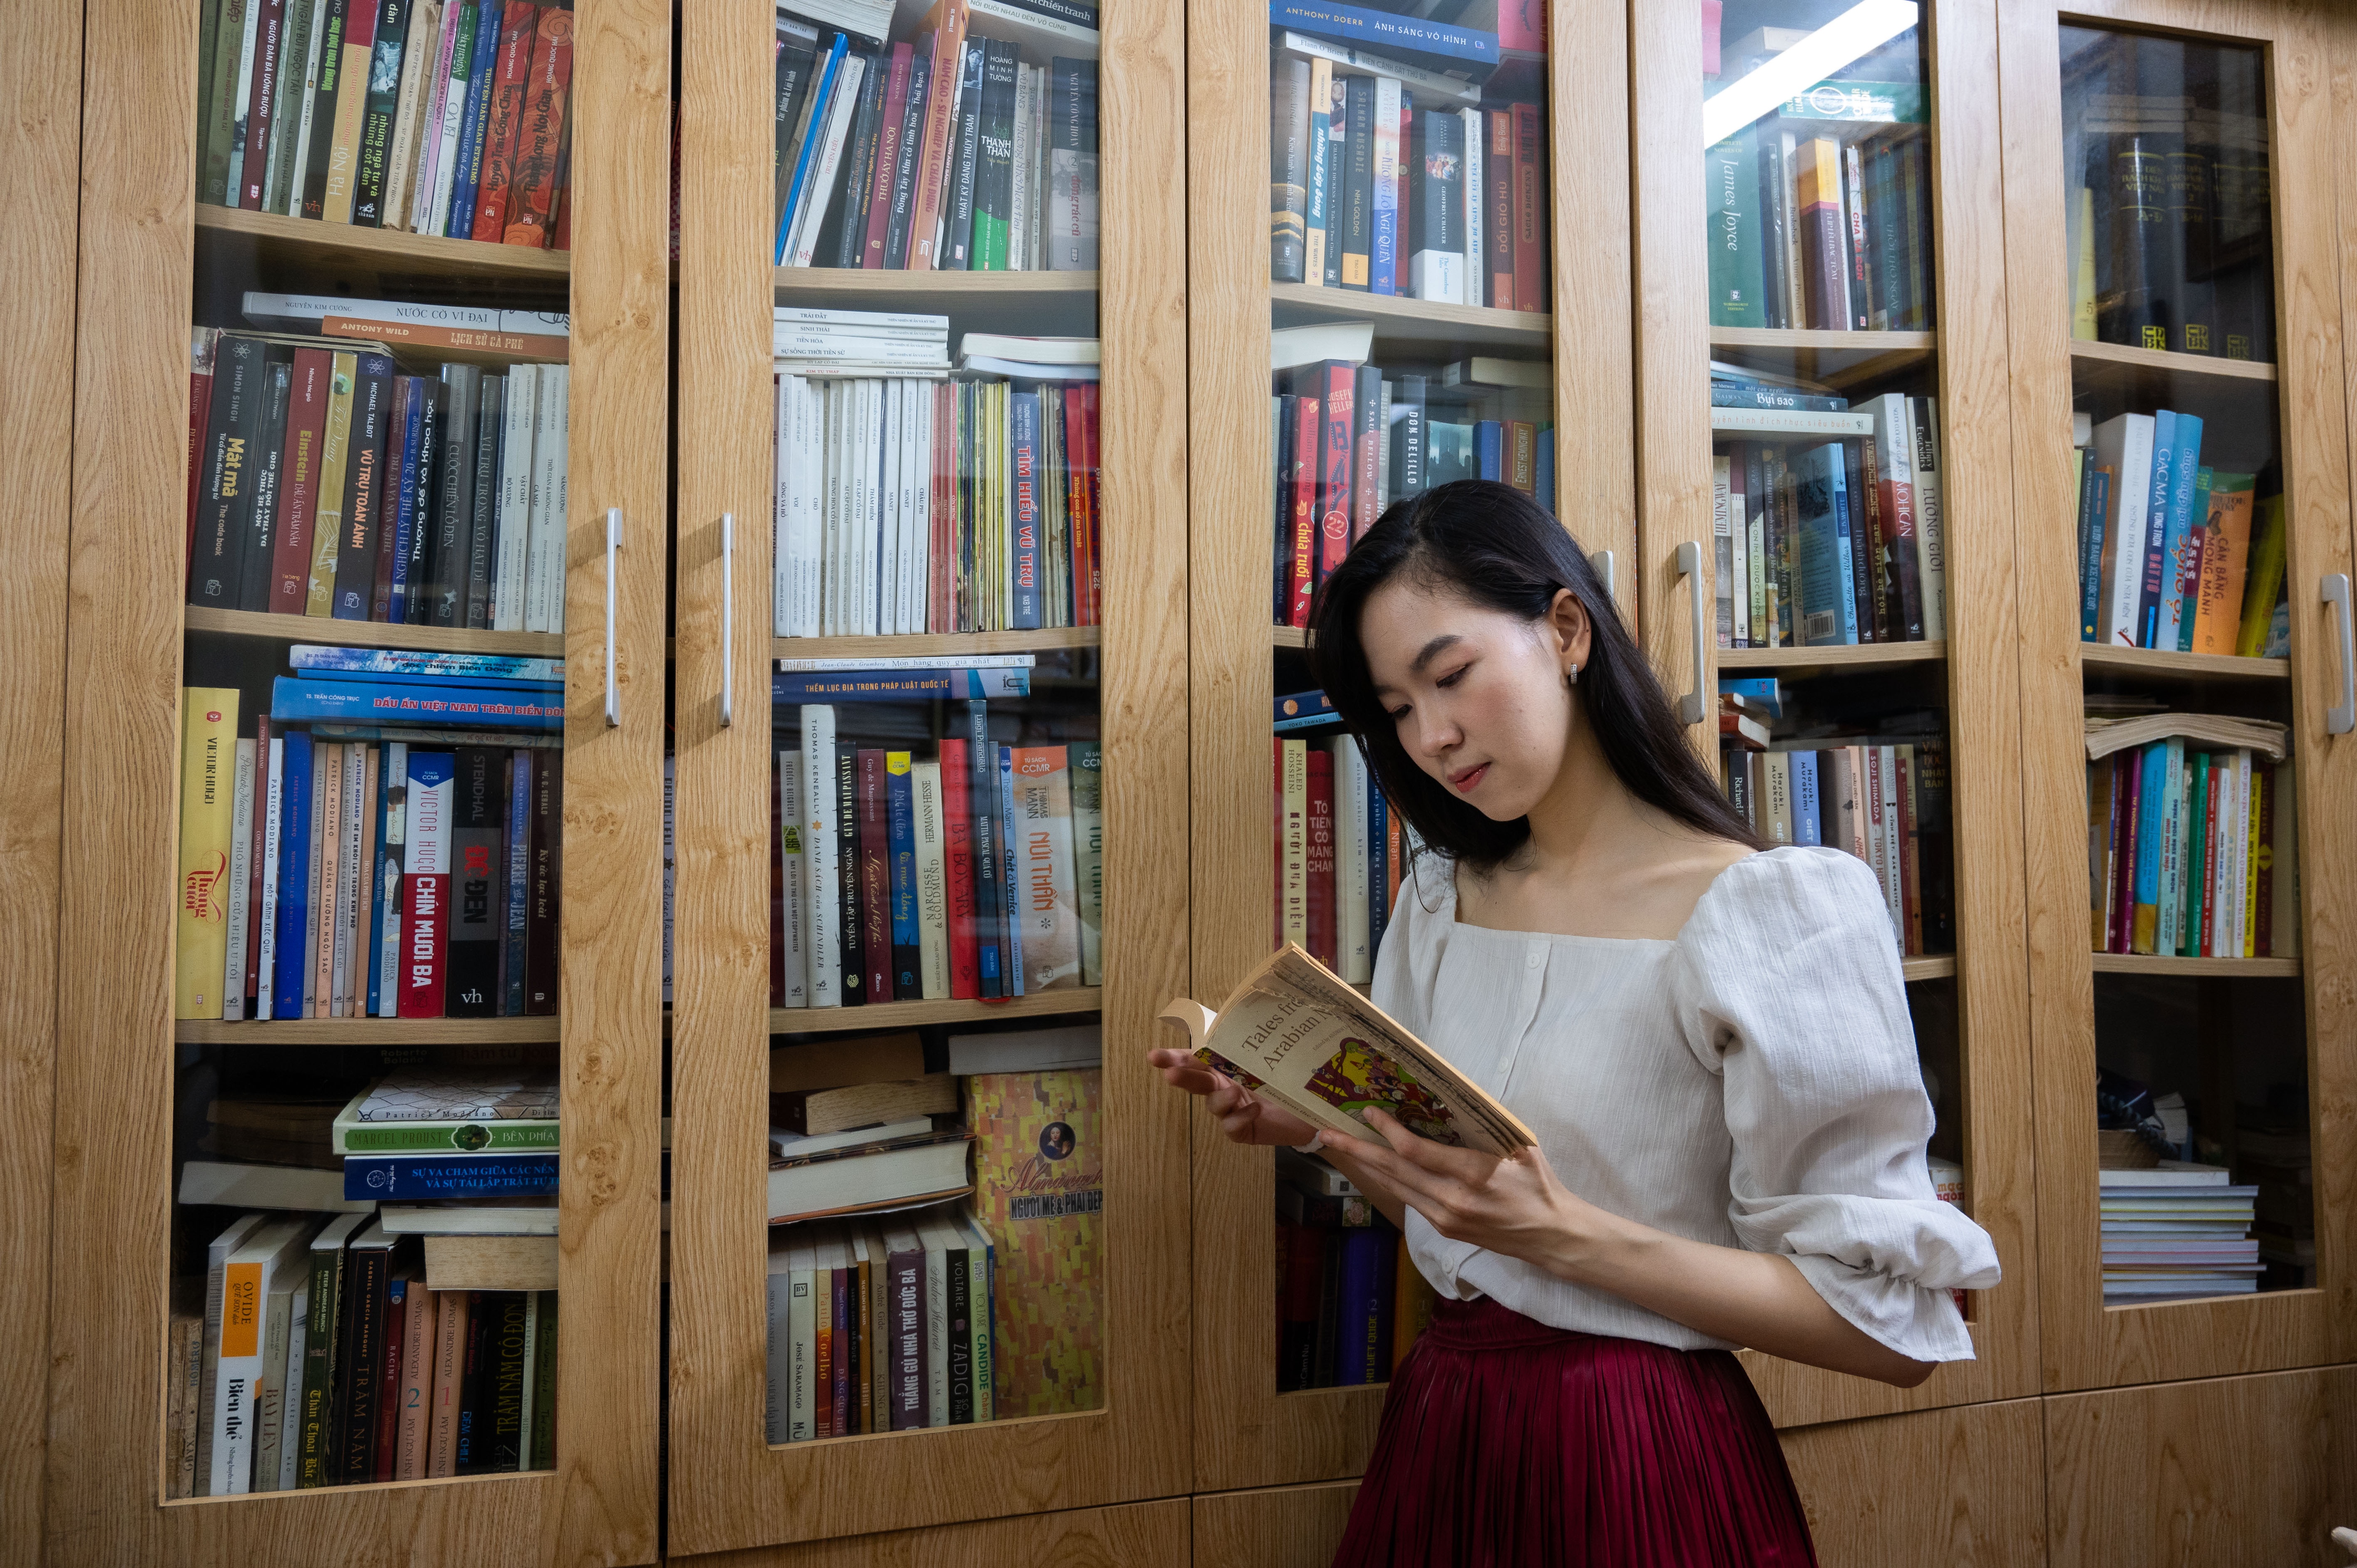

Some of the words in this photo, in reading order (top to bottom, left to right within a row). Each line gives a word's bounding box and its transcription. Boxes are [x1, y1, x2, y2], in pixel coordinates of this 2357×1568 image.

[1001, 8, 1020, 17] NHAU
[1022, 13, 1035, 22] ĐẾN
[1286, 7, 1330, 20] ANTHONY
[1334, 15, 1363, 26] DOERR
[268, 19, 277, 45] NGƯỜI
[1301, 39, 1317, 50] Flann
[1375, 21, 1394, 32] ÁNH
[1398, 25, 1424, 37] SÁNG
[1427, 31, 1439, 40] VÔ
[1443, 33, 1466, 45] HÌNH
[265, 61, 272, 72] BÀ
[990, 56, 1012, 64] HOÀNG
[263, 73, 272, 96] UỐNG
[990, 74, 1012, 82] TƯỜNG
[260, 96, 269, 117] RƯỢU
[333, 147, 350, 172] Nội
[963, 160, 972, 183] ĐẶNG
[329, 176, 345, 196] Hà
[961, 184, 969, 196] KÝ
[1719, 158, 1740, 205] James
[1722, 210, 1741, 251] Joyce
[396, 305, 428, 320] NƯỚC
[432, 307, 447, 320] CỜ
[468, 312, 488, 323] ĐẠI
[341, 323, 383, 333] ANTONY
[386, 327, 410, 336] WILD
[234, 365, 243, 393] SIMON
[231, 395, 240, 422] SINGH
[369, 382, 377, 412] MICHAEL
[1327, 389, 1353, 402] JOSEPH
[1328, 401, 1353, 414] HELLER
[1756, 393, 1775, 407] Bụi
[1777, 396, 1794, 406] sao
[366, 413, 375, 438] TALBOT
[226, 437, 246, 468] Mật
[295, 430, 312, 482] Einstein
[1518, 428, 1528, 461] HEMINGWAY
[1018, 446, 1035, 477] TÌM
[1303, 455, 1313, 493] Golding
[1515, 461, 1527, 483] ERNEST
[222, 470, 238, 497] mã
[220, 504, 228, 519] The
[1019, 482, 1038, 521] HIỂU
[1715, 481, 1730, 536] HEMINGWAY
[1895, 482, 1911, 538] MOHICAN
[217, 520, 226, 536] code
[1020, 526, 1036, 548] VŨ
[1329, 516, 1345, 533] 22
[215, 538, 224, 556] book
[1018, 553, 1033, 587] TRỤ
[2174, 535, 2188, 595] QUỐC
[805, 684, 824, 693] THỀM
[827, 684, 840, 692] LỤC
[842, 683, 855, 692] ĐỊA
[857, 682, 879, 691] TRONG
[881, 681, 899, 690] PHÁP
[901, 681, 918, 689] LUẬT
[920, 679, 938, 689] QUỐC
[940, 679, 950, 688] TẾ
[374, 697, 398, 708] DẤU
[401, 698, 418, 709] ẤN
[421, 699, 448, 711] VIỆT
[450, 703, 479, 712] NAM
[481, 703, 512, 714] TRÊN
[514, 703, 542, 716] BIỂN
[206, 737, 217, 773] VICTOR
[1022, 764, 1050, 773] CCMR
[205, 774, 215, 804] HUGO
[472, 755, 485, 821] STENDHAL
[922, 780, 931, 800] HESSE
[1871, 778, 1880, 820] SHIMADA
[419, 790, 438, 832] VICTOR
[923, 802, 934, 843] HERMANN
[414, 840, 436, 872] HUGO
[415, 877, 439, 914] CHÍN
[923, 867, 934, 920] NARCISSE
[930, 859, 942, 919] GOLDMUND
[412, 965, 432, 988] BA
[1241, 1013, 1284, 1052] Tales
[1278, 997, 1303, 1016] fro
[1263, 1016, 1321, 1071] Arabian
[1264, 1088, 1280, 1100] Tales
[902, 1268, 916, 1284] BÀ
[955, 1261, 964, 1308] VOLTAIRE
[241, 1282, 253, 1325] OVIDE
[899, 1286, 917, 1309] ĐỨC
[414, 1300, 423, 1330] DUMAS
[411, 1331, 421, 1379] ALEXANDRE
[902, 1332, 918, 1356] NHÀ
[387, 1346, 396, 1381] RACINE
[904, 1357, 918, 1372] GÙ
[954, 1343, 968, 1394] ZADIG
[977, 1334, 989, 1390] CANDIDE
[898, 1375, 919, 1411] THẰNG
